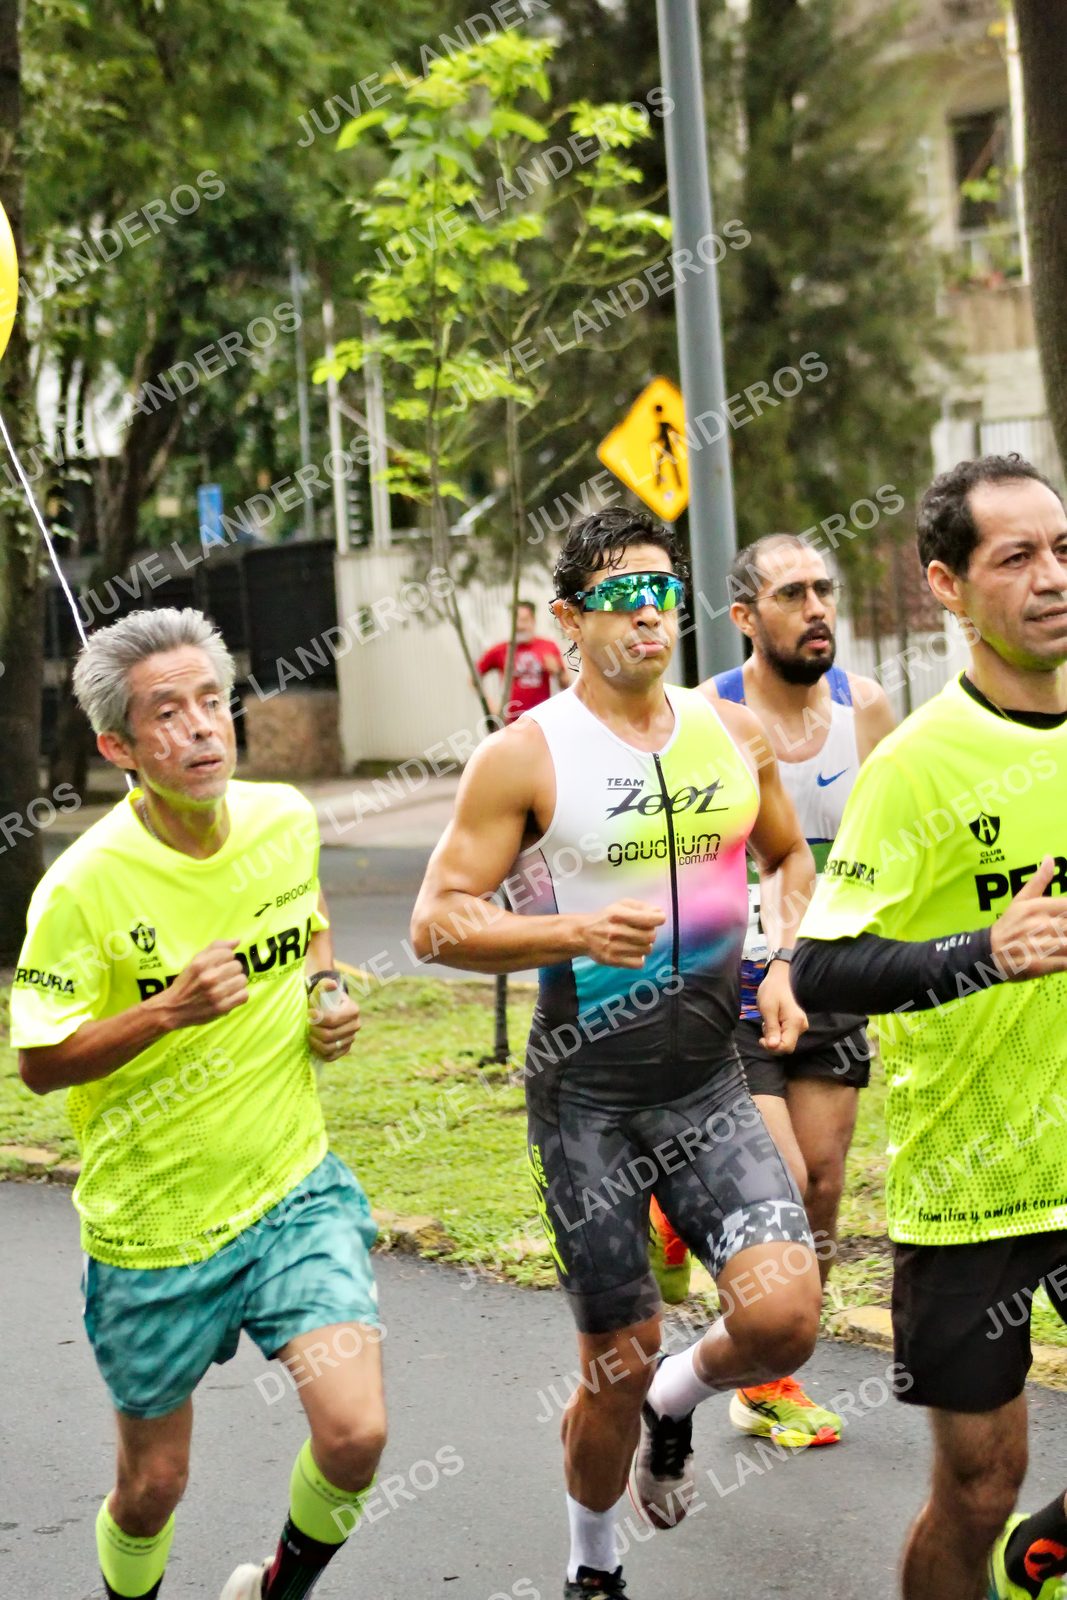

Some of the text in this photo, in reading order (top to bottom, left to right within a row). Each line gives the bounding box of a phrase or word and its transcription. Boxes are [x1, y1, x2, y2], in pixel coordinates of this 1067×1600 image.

[607, 778, 644, 787] TEAM
[678, 852, 718, 866] com.mx
[980, 848, 1002, 857] CLUB
[980, 855, 1005, 865] ATLAS
[824, 860, 875, 885] RDURA
[15, 968, 75, 993] RDURA
[971, 1210, 980, 1224] y
